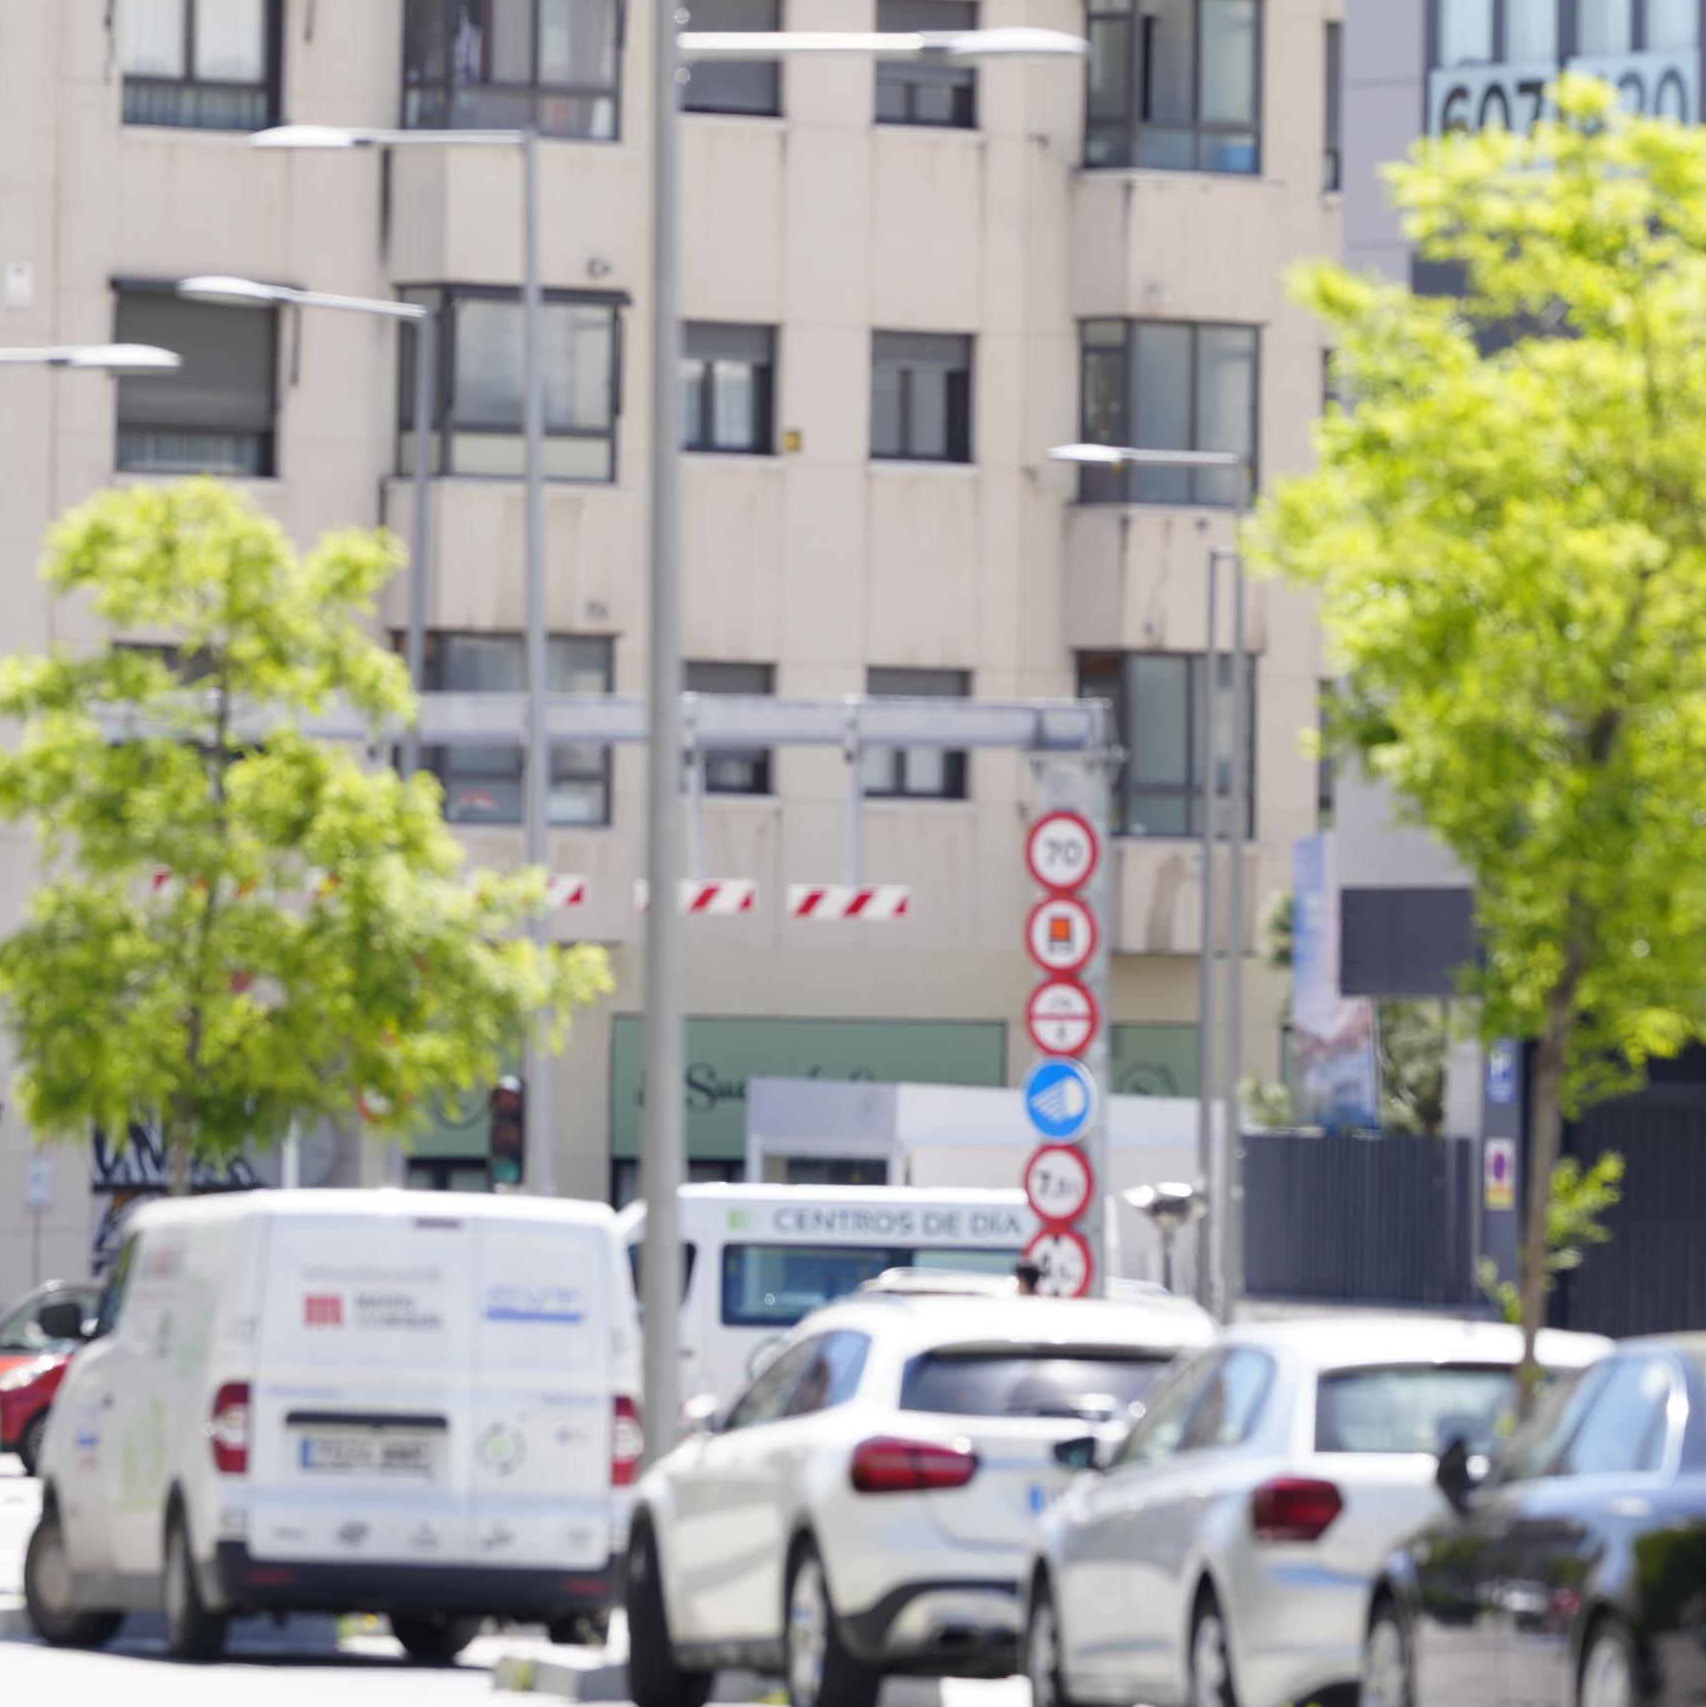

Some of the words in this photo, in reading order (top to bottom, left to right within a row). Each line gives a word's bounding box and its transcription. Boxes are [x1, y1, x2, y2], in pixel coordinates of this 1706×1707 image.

[1043, 837, 1083, 869] 70
[773, 1208, 913, 1236] CENTROS
[922, 1211, 962, 1237] DE
[969, 1206, 1024, 1238] DÍA
